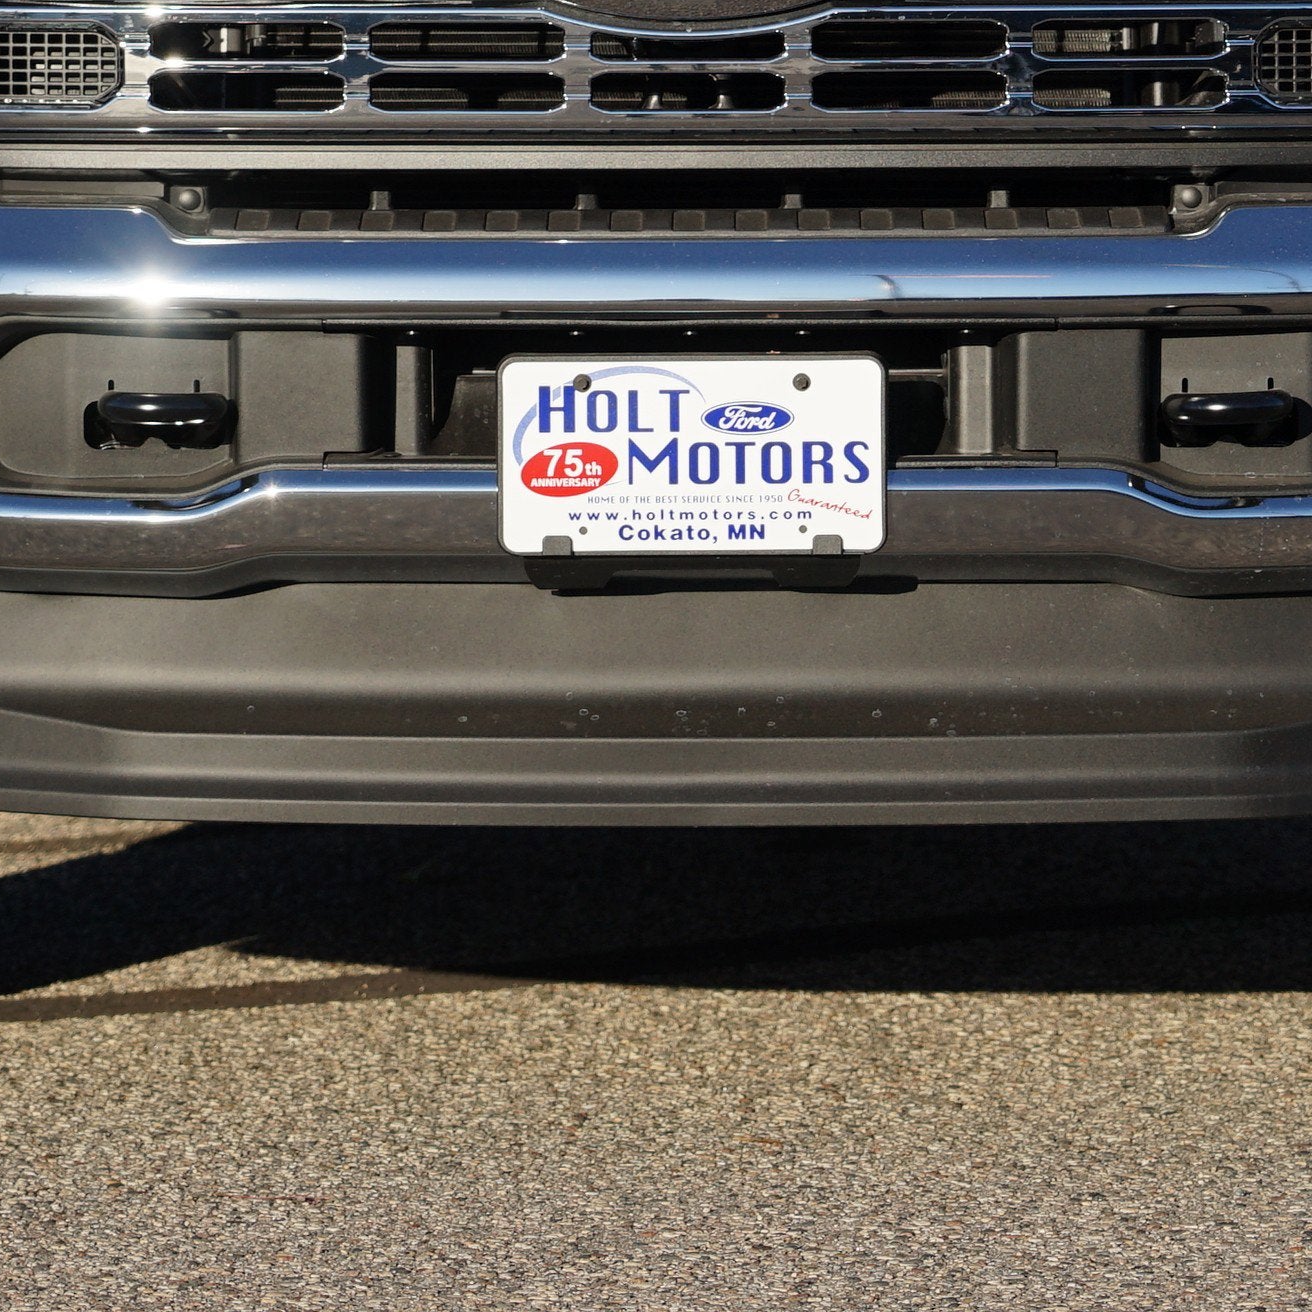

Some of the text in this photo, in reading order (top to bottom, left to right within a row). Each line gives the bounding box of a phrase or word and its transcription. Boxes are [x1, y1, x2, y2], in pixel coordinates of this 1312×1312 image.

[538, 385, 690, 434] HOLT
[718, 405, 777, 430] Ford
[542, 448, 603, 478] 75th
[627, 437, 870, 486] MOTORS
[530, 477, 602, 488] ANNIVERSARY
[587, 494, 783, 504] HOME OF THE BEST SERVICE SINCE 1950
[787, 488, 874, 520] Guaranteed
[568, 509, 813, 521] www.holtmotors.com
[618, 524, 766, 543] Cokato, MN
